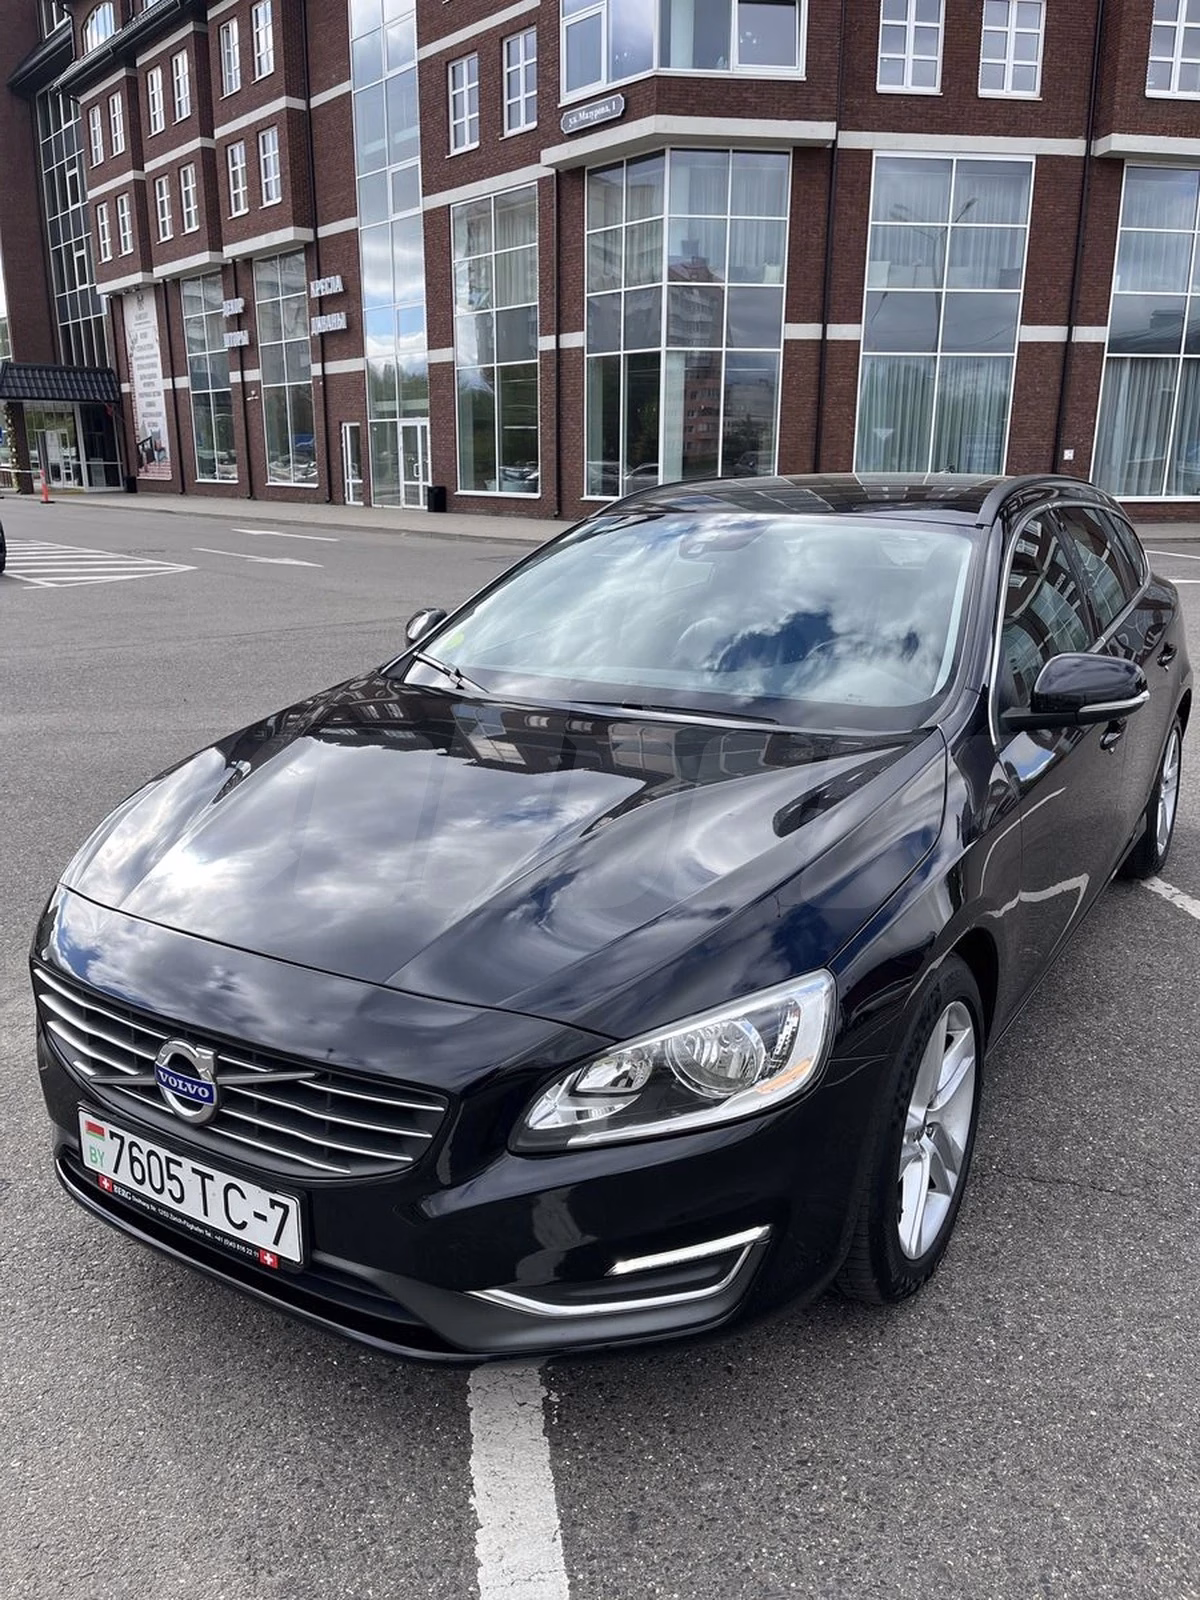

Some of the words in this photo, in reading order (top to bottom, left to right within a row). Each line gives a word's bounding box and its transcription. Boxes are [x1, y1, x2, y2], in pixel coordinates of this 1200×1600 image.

[157, 1069, 210, 1098] VOLVO
[90, 1147, 106, 1168] BY
[113, 1183, 132, 1201] BERG
